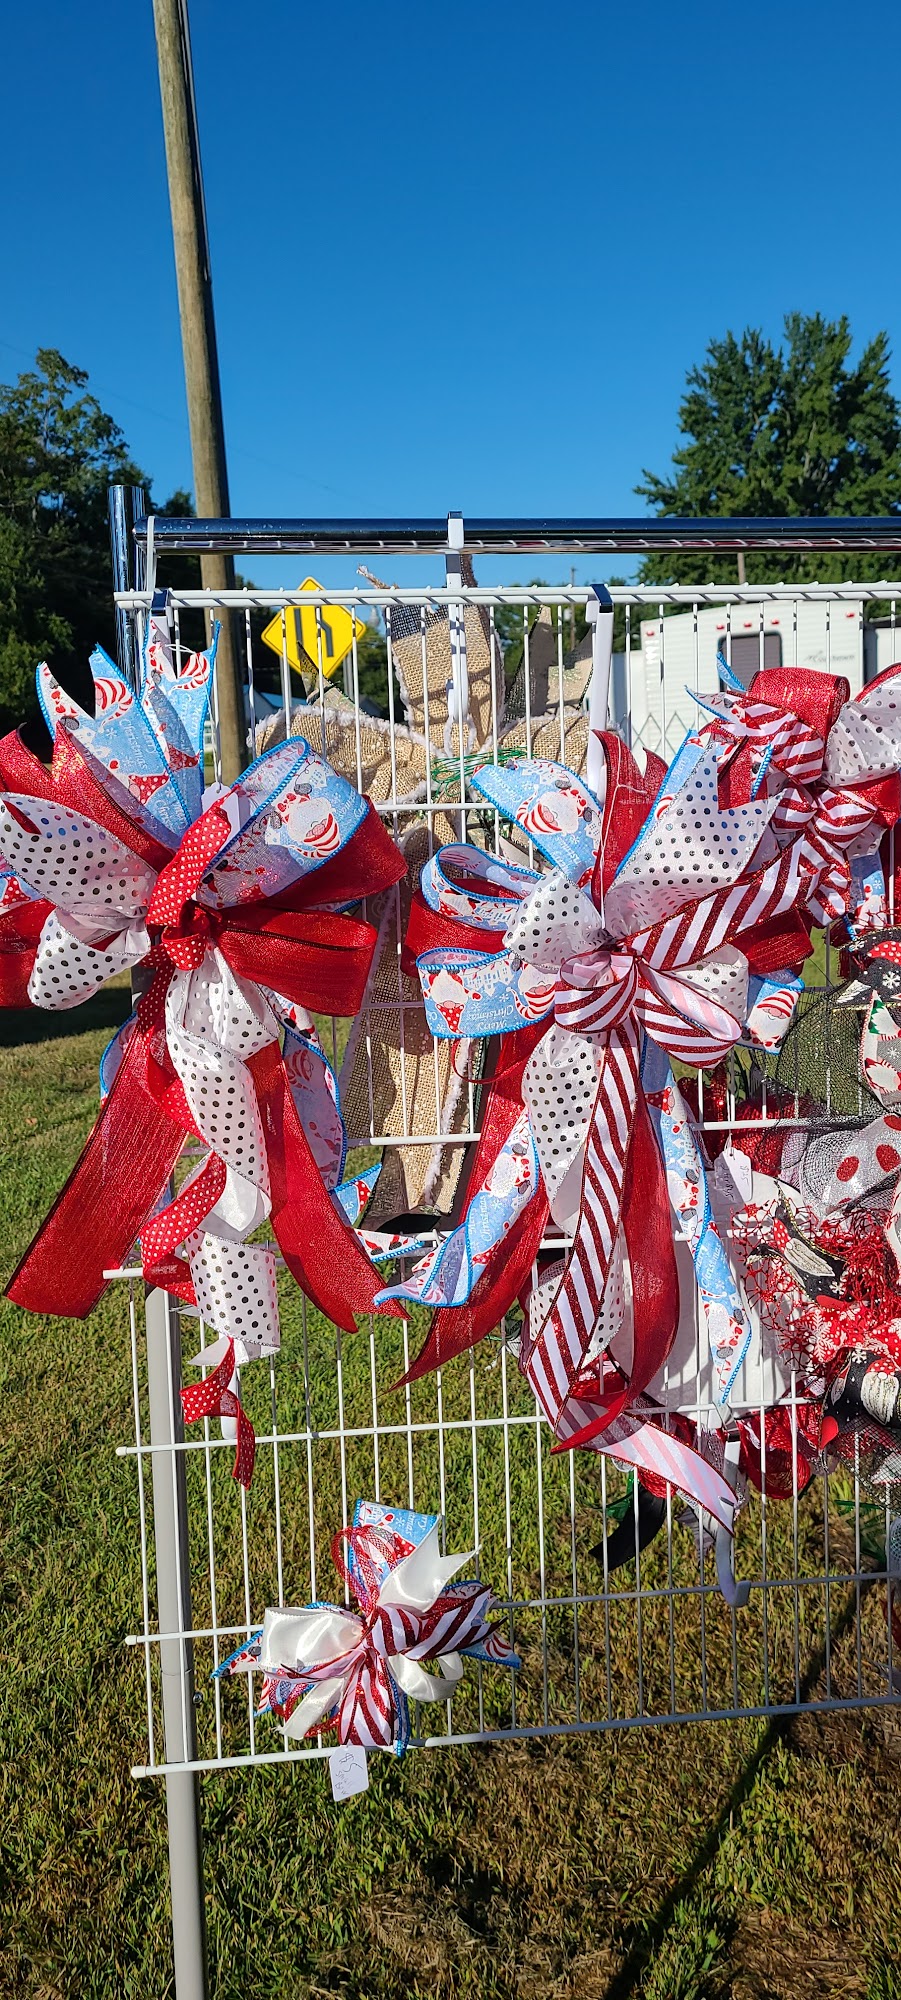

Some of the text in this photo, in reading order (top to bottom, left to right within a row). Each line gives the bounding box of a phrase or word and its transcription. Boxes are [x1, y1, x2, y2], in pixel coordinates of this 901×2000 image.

[119, 719, 148, 769] Christmas
[468, 1005, 514, 1020] Christmas
[477, 1020, 507, 1032] Merry
[480, 1195, 492, 1242] Christmas
[701, 1243, 721, 1288] Christmas
[339, 1753, 363, 1773] $5
